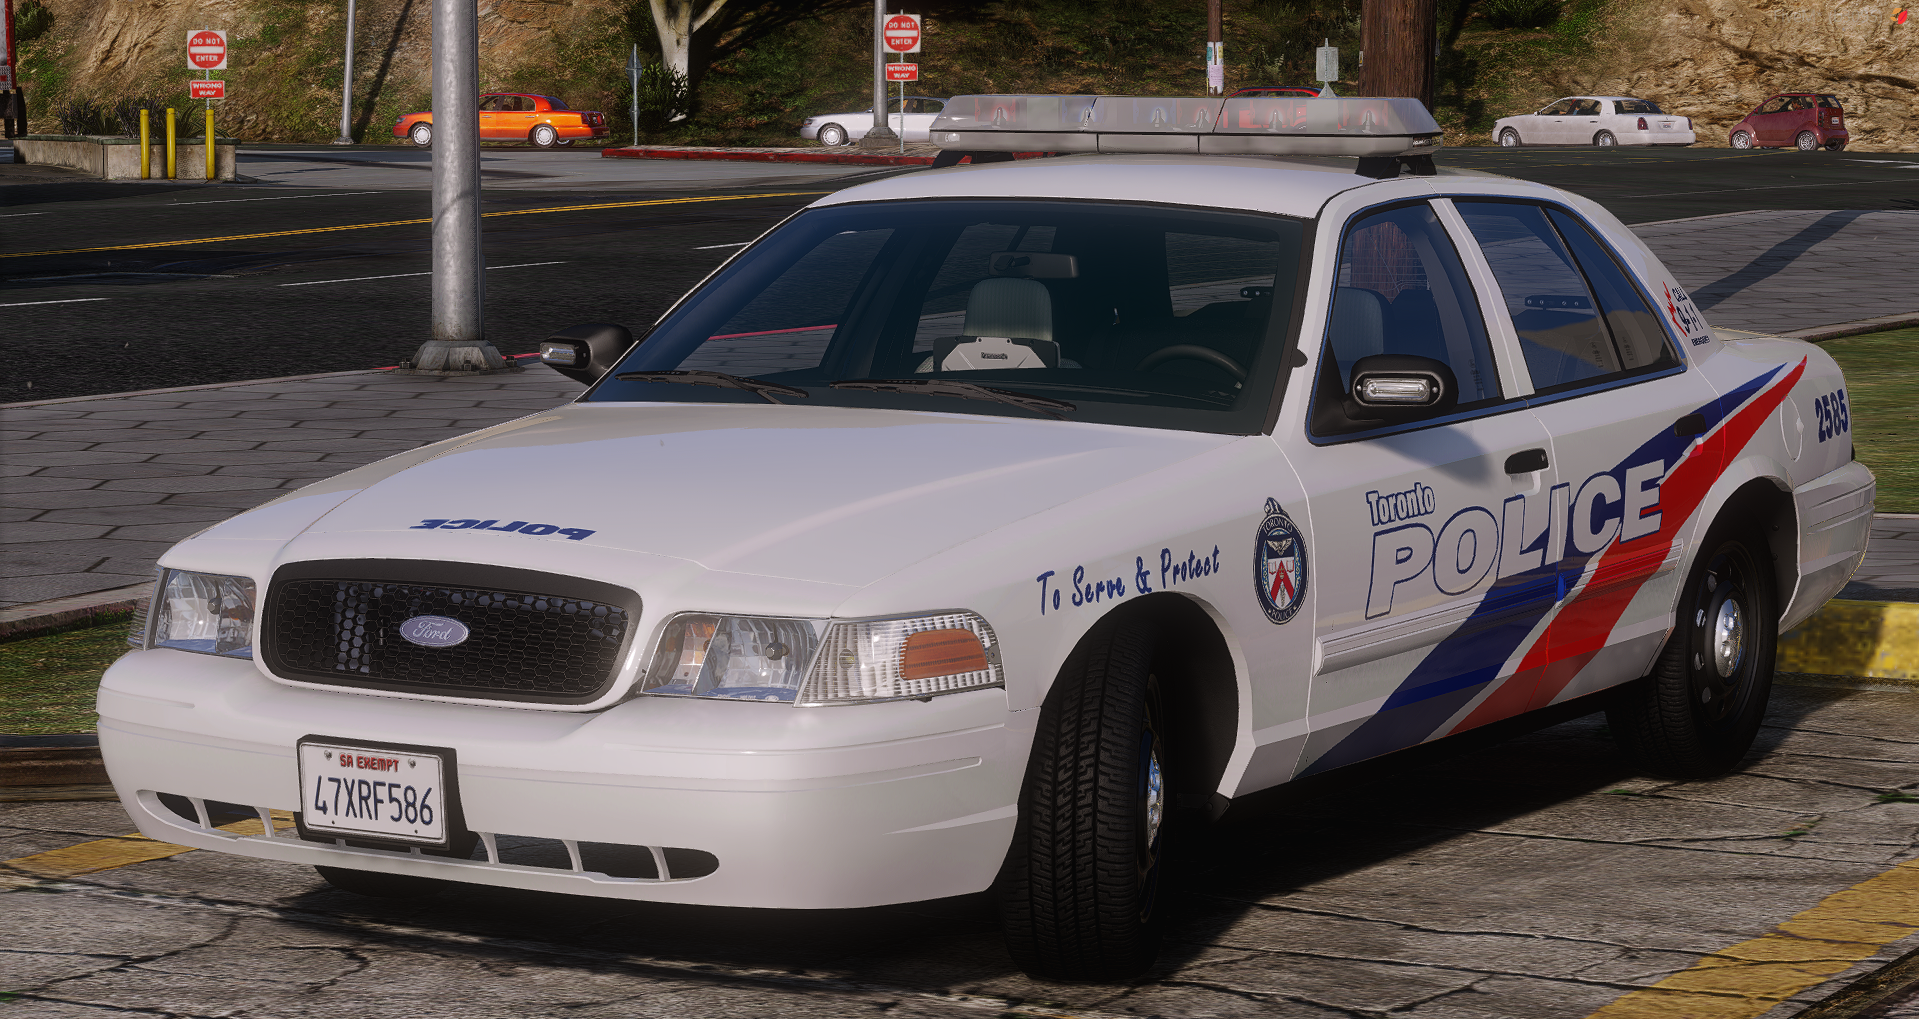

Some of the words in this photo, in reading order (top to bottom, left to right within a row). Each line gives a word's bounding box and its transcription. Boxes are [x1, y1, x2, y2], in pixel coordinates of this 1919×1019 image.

[1814, 388, 1849, 443] 2585
[1263, 517, 1293, 535] TORONTO
[1365, 481, 1436, 527] Toronto
[1364, 458, 1665, 621] POLICE
[1036, 570, 1061, 616] To
[1071, 565, 1126, 607] Serve
[1135, 555, 1152, 594] &
[1160, 544, 1220, 589] Protect
[412, 620, 453, 641] Ford
[339, 753, 354, 768] SA
[356, 755, 400, 772] EXEMPT
[314, 774, 434, 826] 47XRF586
